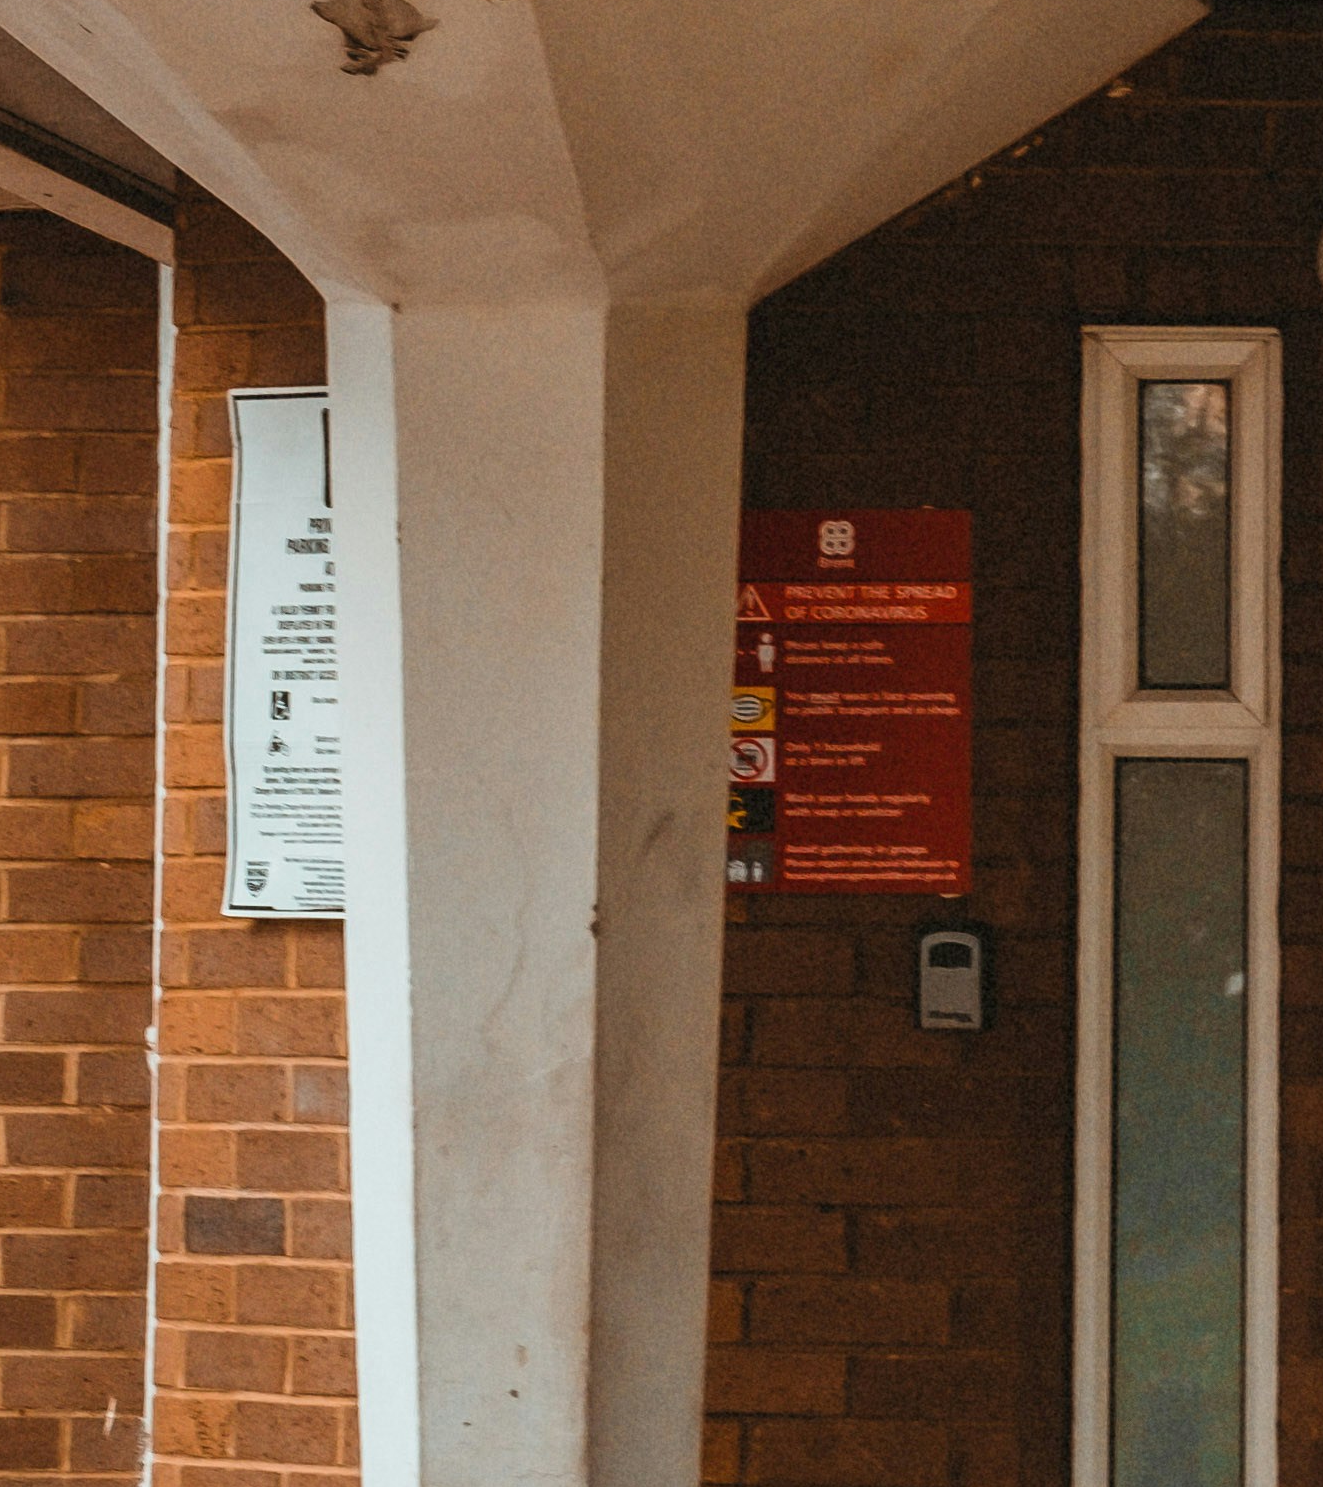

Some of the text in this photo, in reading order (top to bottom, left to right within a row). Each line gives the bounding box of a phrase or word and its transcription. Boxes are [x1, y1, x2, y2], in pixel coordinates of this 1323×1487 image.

[784, 584, 958, 599] PREVENT THE SPREAD
[784, 605, 929, 620] OF CORONAVIRUS
